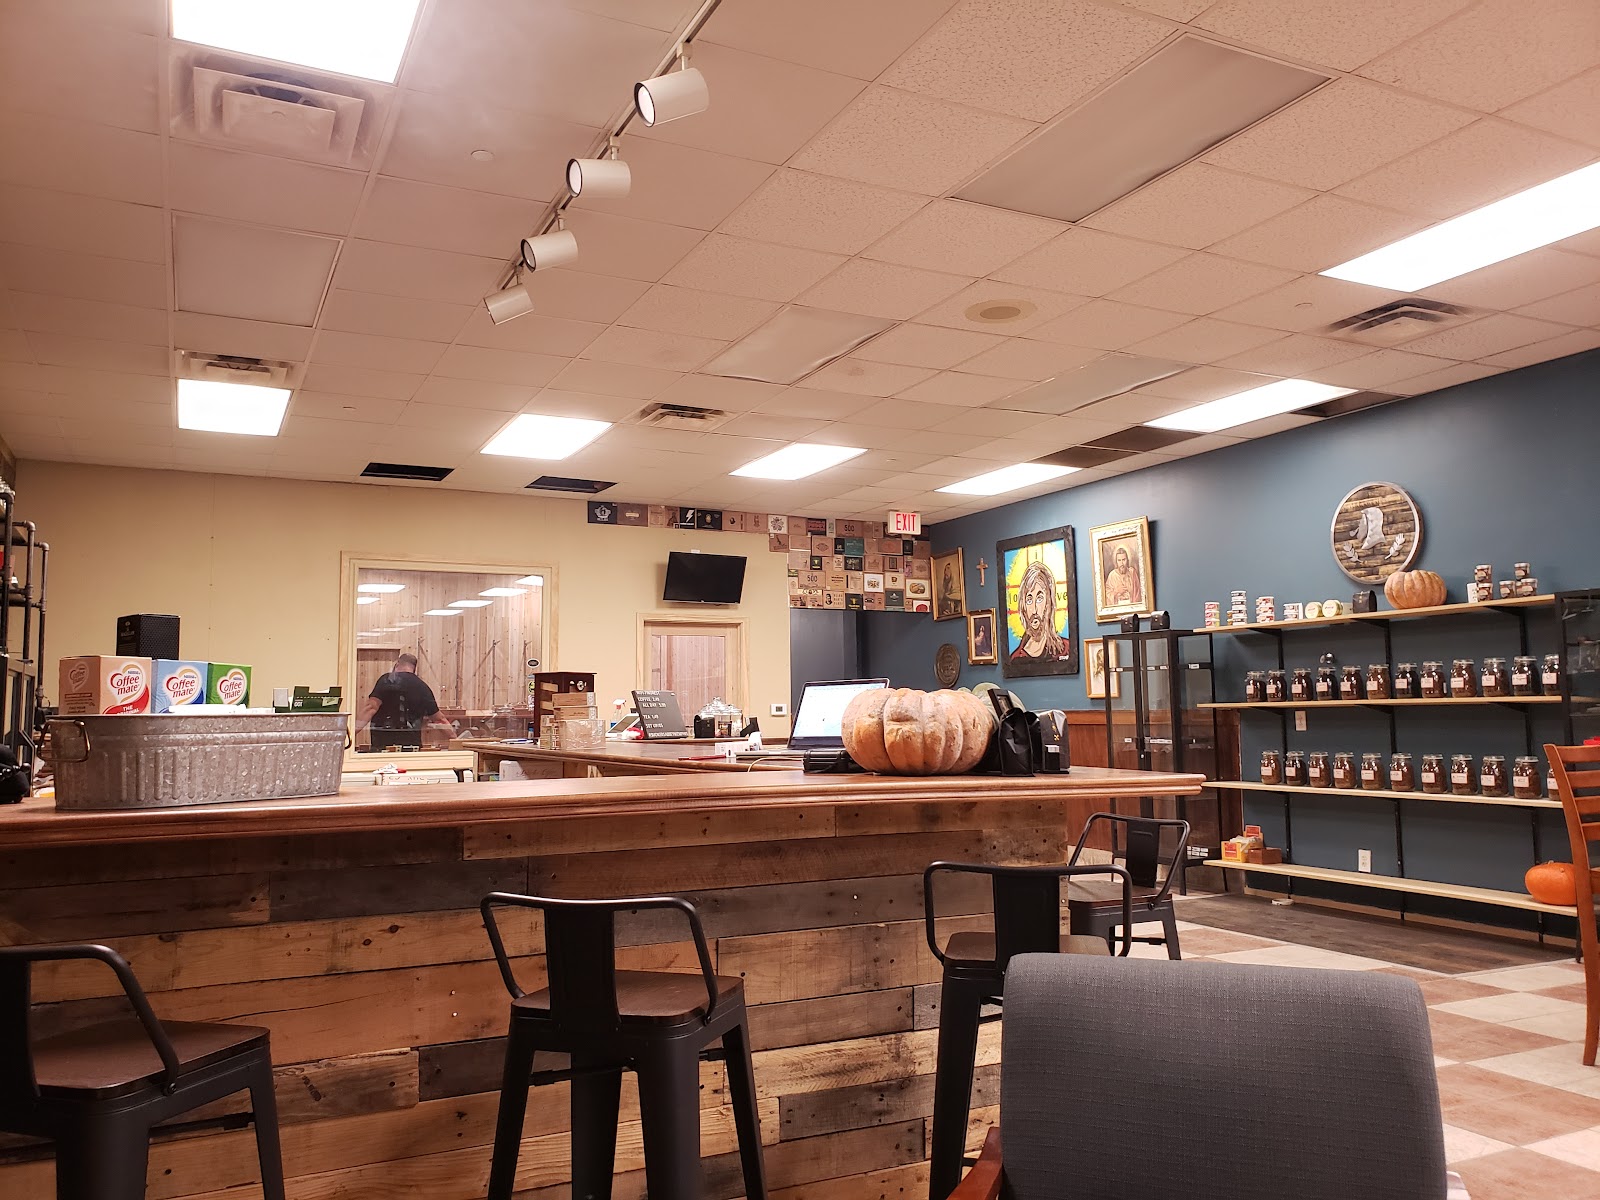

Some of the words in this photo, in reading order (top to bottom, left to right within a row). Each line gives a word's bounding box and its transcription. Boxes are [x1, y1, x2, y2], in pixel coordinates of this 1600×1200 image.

[895, 513, 917, 532] EXIT
[110, 672, 140, 689] Coffee
[165, 676, 196, 692] Coffee
[219, 679, 242, 694] Coffee
[117, 684, 138, 696] mate
[172, 688, 194, 699] mate
[224, 689, 241, 700] mate
